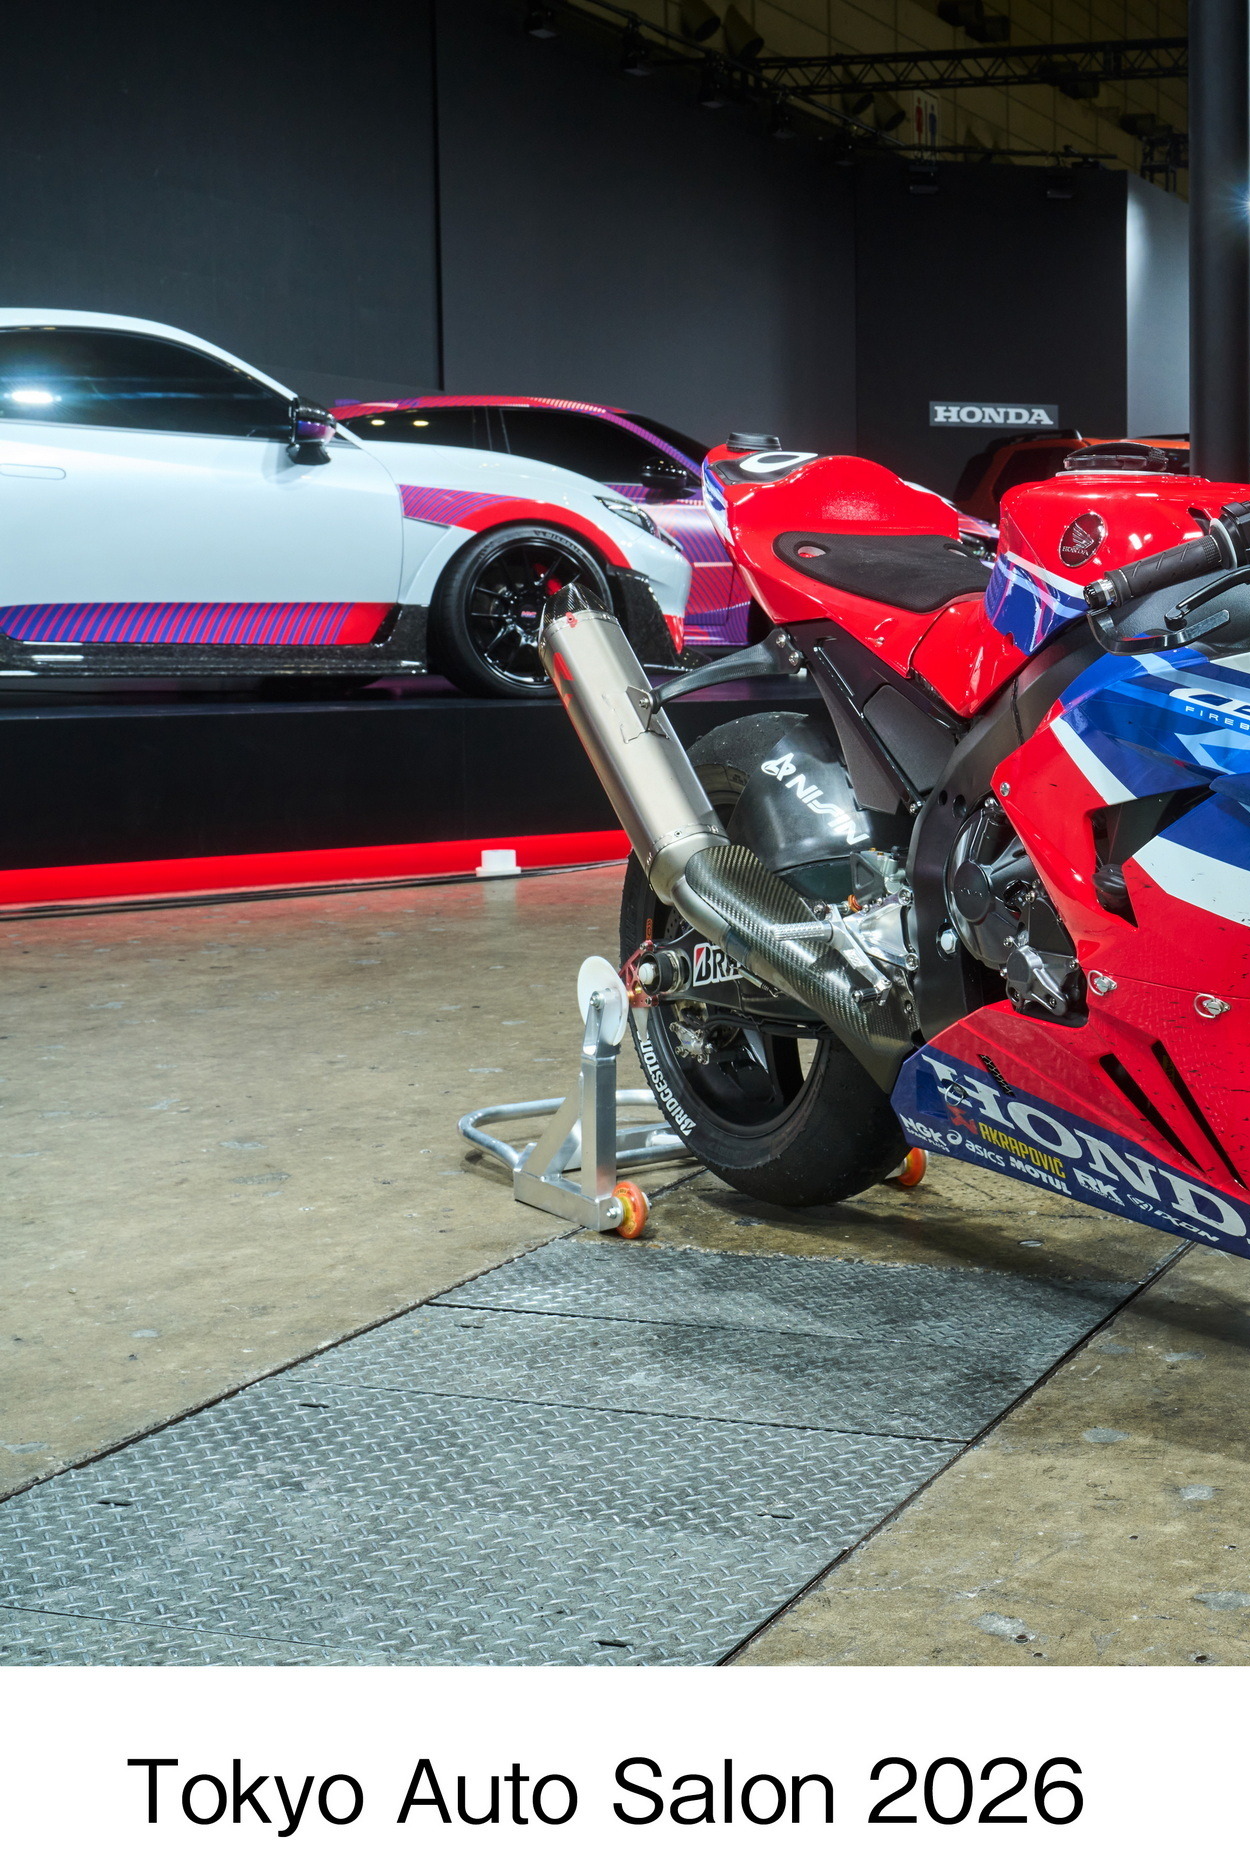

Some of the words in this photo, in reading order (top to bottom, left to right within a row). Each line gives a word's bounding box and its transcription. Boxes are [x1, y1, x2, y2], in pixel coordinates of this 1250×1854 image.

[934, 406, 1054, 425] HONDA
[899, 1113, 937, 1147] NGK
[965, 1139, 1006, 1167] asics
[978, 1122, 1066, 1179] AKRAPOVIČ
[1009, 1156, 1072, 1195] MOTUL
[1073, 1167, 1125, 1206] RK
